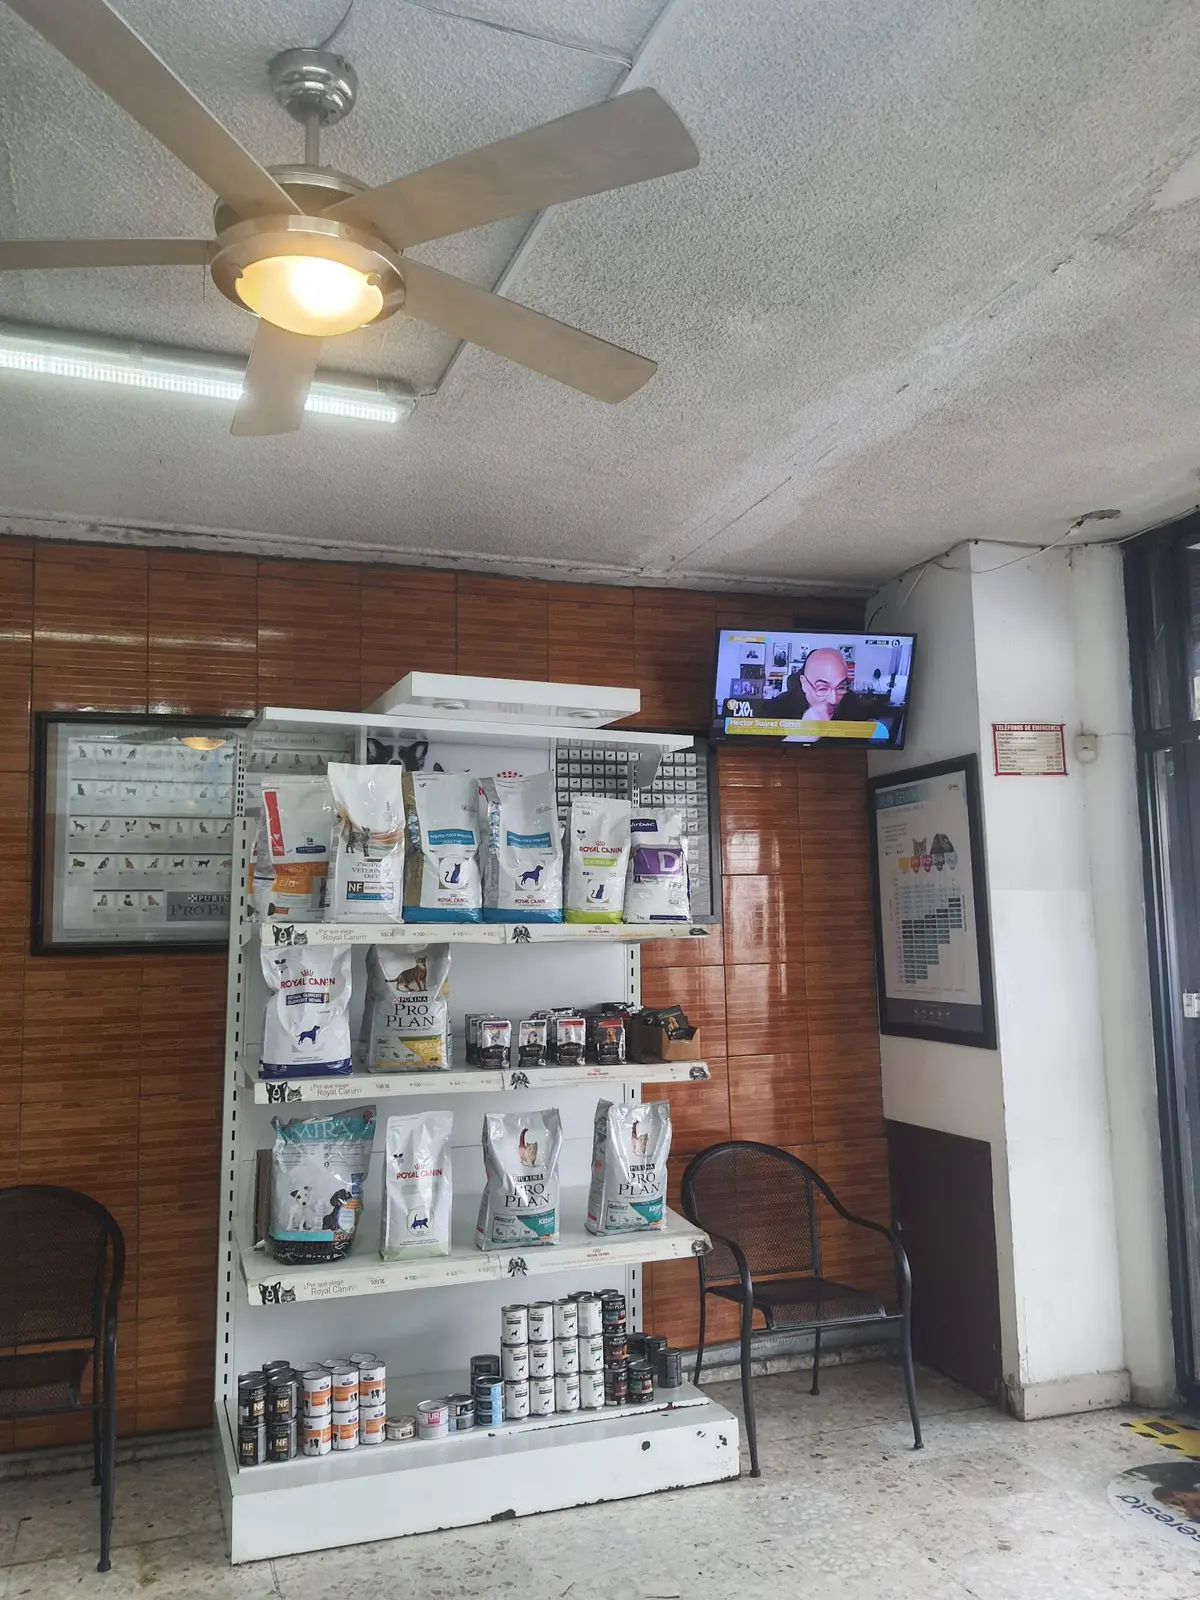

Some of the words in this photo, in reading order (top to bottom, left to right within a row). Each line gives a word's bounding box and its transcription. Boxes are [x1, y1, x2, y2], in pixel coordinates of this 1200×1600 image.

[658, 851, 680, 872] D
[348, 882, 363, 892] NF
[171, 904, 204, 916] PRO
[208, 904, 229, 915] PL
[322, 934, 343, 942] Royal
[280, 978, 307, 988] ROYAL
[309, 978, 336, 986] CANIN
[393, 1004, 429, 1015] PRO
[386, 1015, 434, 1027] PLAN
[317, 1088, 337, 1097] Royal
[396, 1171, 419, 1180] ROYAL
[420, 1169, 443, 1178] CANIN
[514, 1183, 545, 1195] PRO
[618, 1182, 661, 1195] PLAN
[505, 1194, 549, 1208] PLAN
[311, 1286, 331, 1296] Royal
[332, 1284, 357, 1294] Canin?
[254, 1401, 265, 1411] NF
[277, 1399, 289, 1408] NF
[428, 1411, 440, 1420] UR
[242, 1442, 253, 1450] NF
[276, 1438, 288, 1446] NF
